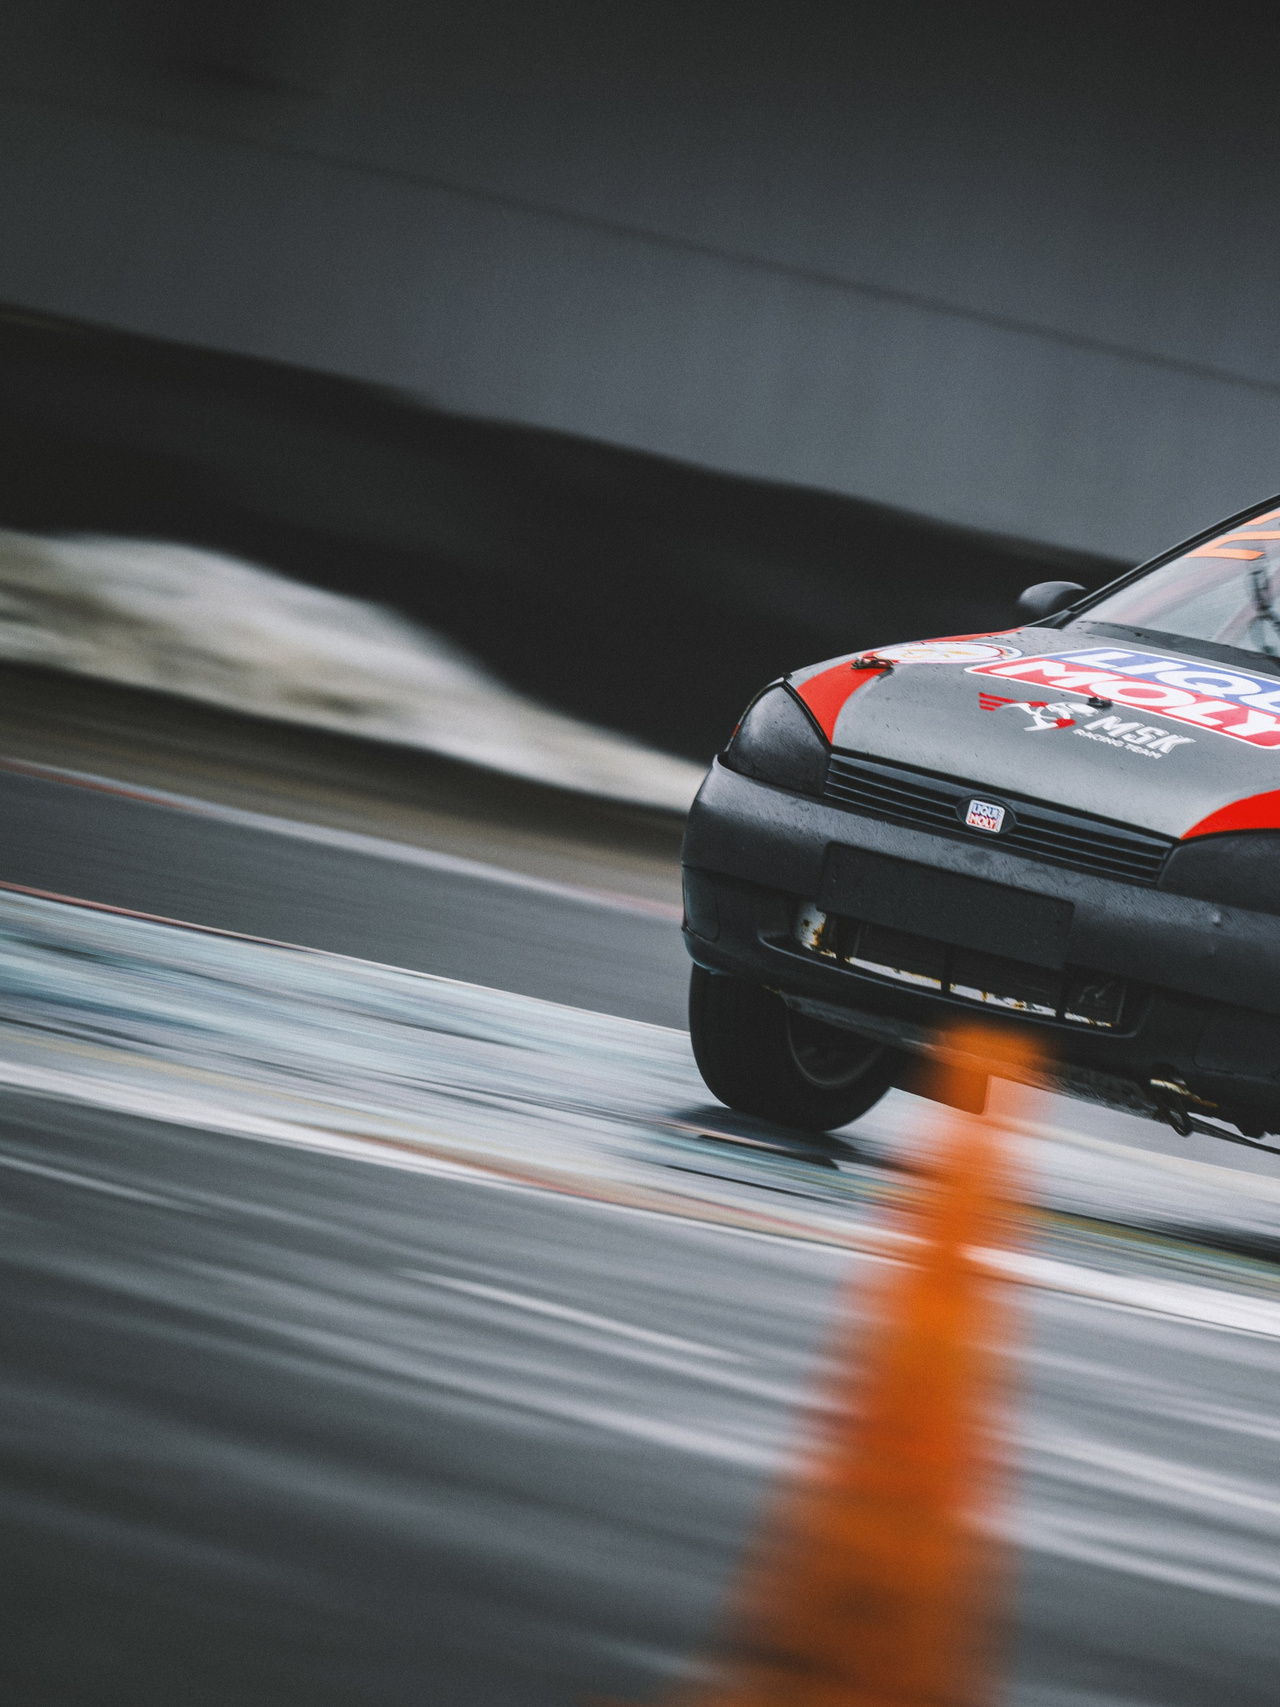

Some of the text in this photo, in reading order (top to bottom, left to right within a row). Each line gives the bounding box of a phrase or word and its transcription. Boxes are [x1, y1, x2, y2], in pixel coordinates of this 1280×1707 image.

[1083, 715, 1197, 754] MSK
[972, 802, 999, 820] LIQUI
[969, 812, 998, 830] MOLY
